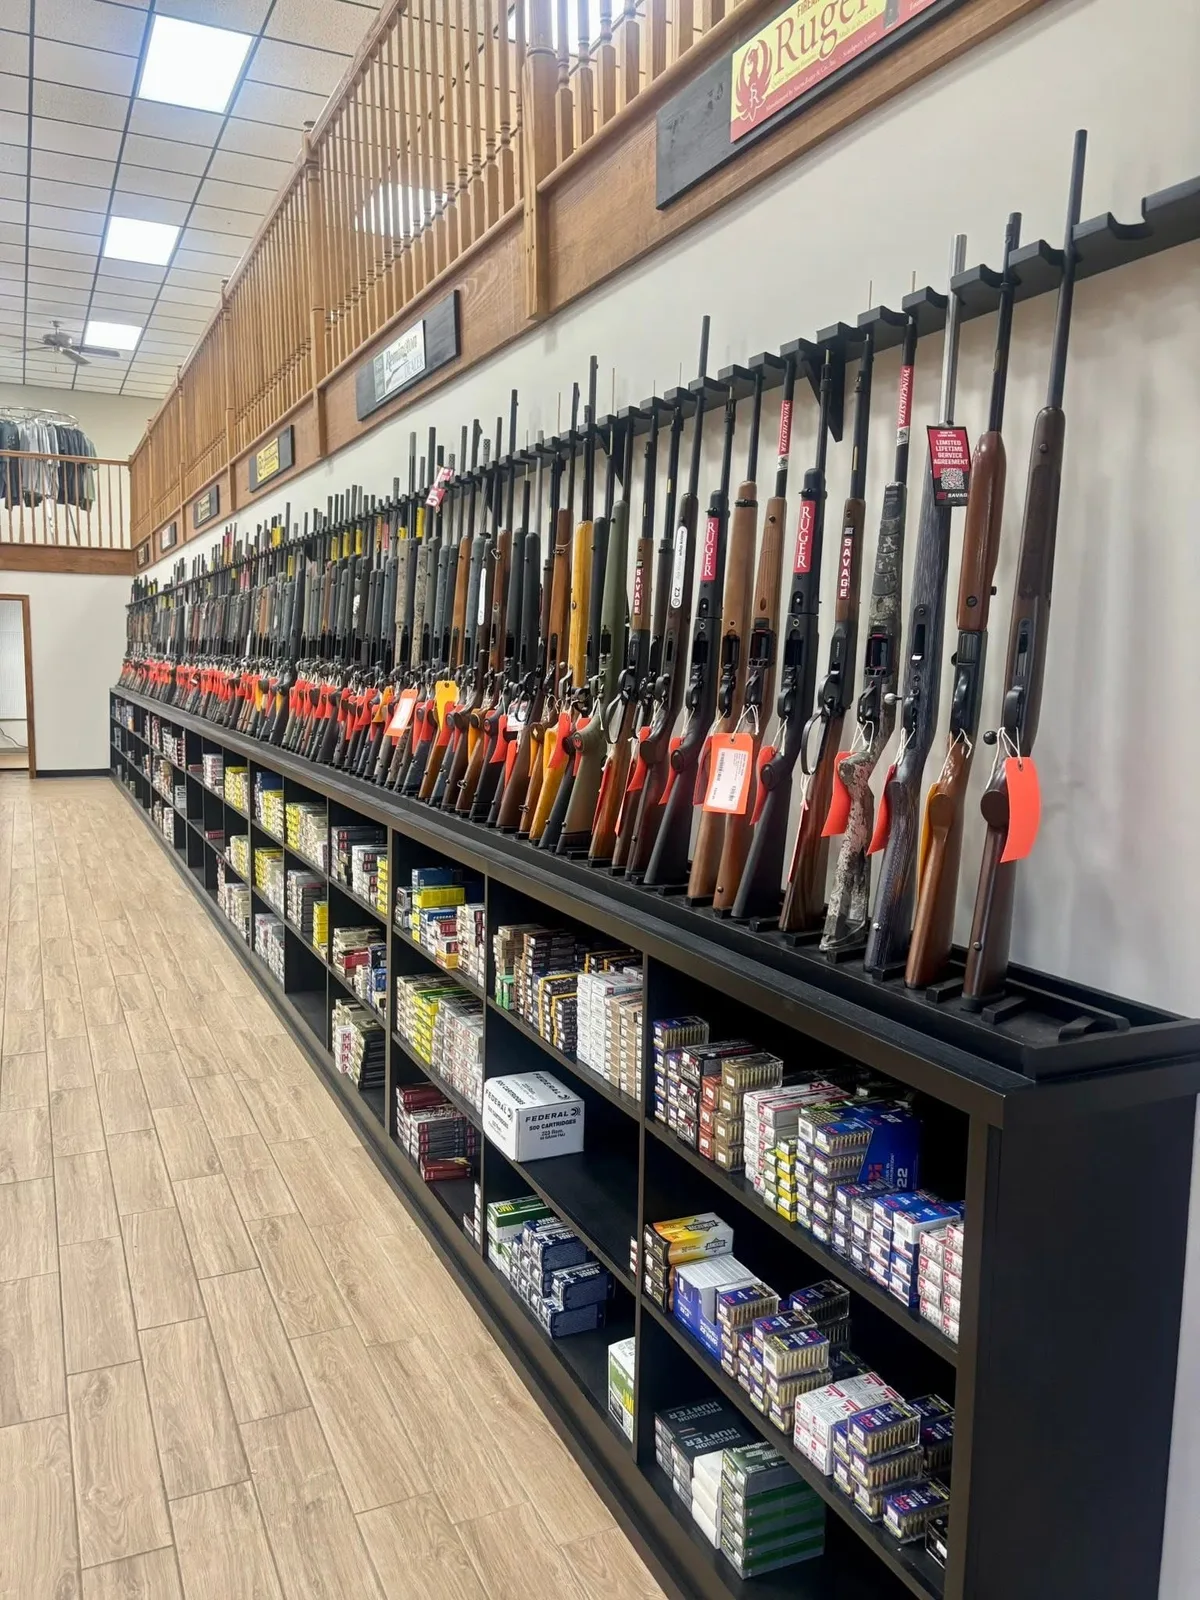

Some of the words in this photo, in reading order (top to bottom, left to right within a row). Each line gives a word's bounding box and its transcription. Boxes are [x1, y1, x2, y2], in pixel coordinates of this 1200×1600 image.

[898, 367, 911, 425] WINCHESTER
[780, 402, 791, 453] WINCHESTER
[704, 521, 715, 577] RUGER
[796, 506, 811, 568] RUGER
[840, 538, 852, 597] SAVAGE
[634, 568, 642, 614] SAVAGE
[485, 1088, 507, 1115] FEDERAL
[525, 1110, 569, 1123] FEDERAL
[529, 1124, 541, 1132] 500
[541, 1118, 577, 1130] CARTRIDGES
[897, 1167, 908, 1189] 22
[668, 1401, 720, 1420] HUNTER
[684, 1427, 738, 1447] HUNTER
